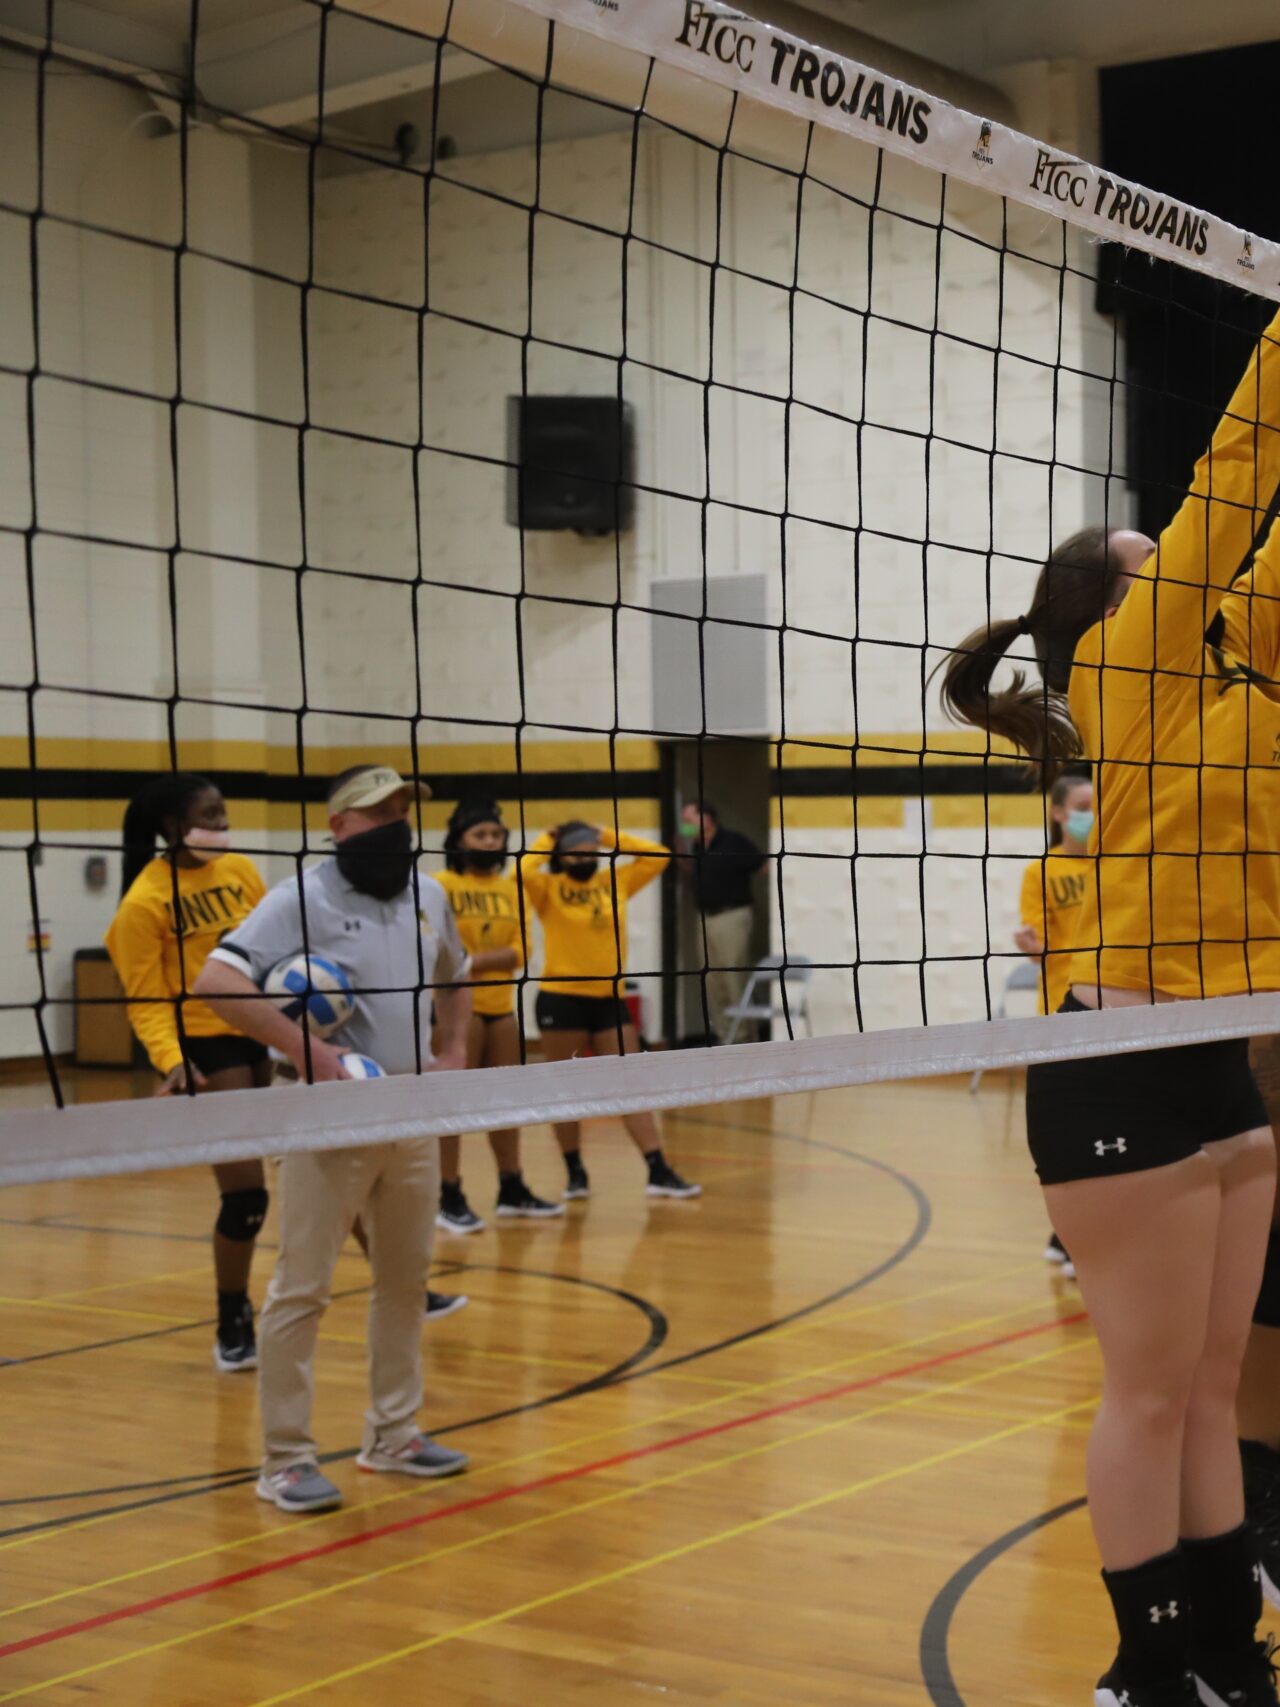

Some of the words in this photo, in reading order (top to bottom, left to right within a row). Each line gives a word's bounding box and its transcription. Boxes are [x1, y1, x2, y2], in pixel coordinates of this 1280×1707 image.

[769, 38, 931, 144] TROJANS
[1093, 176, 1208, 256] TROJANS
[163, 884, 244, 935] UNITY
